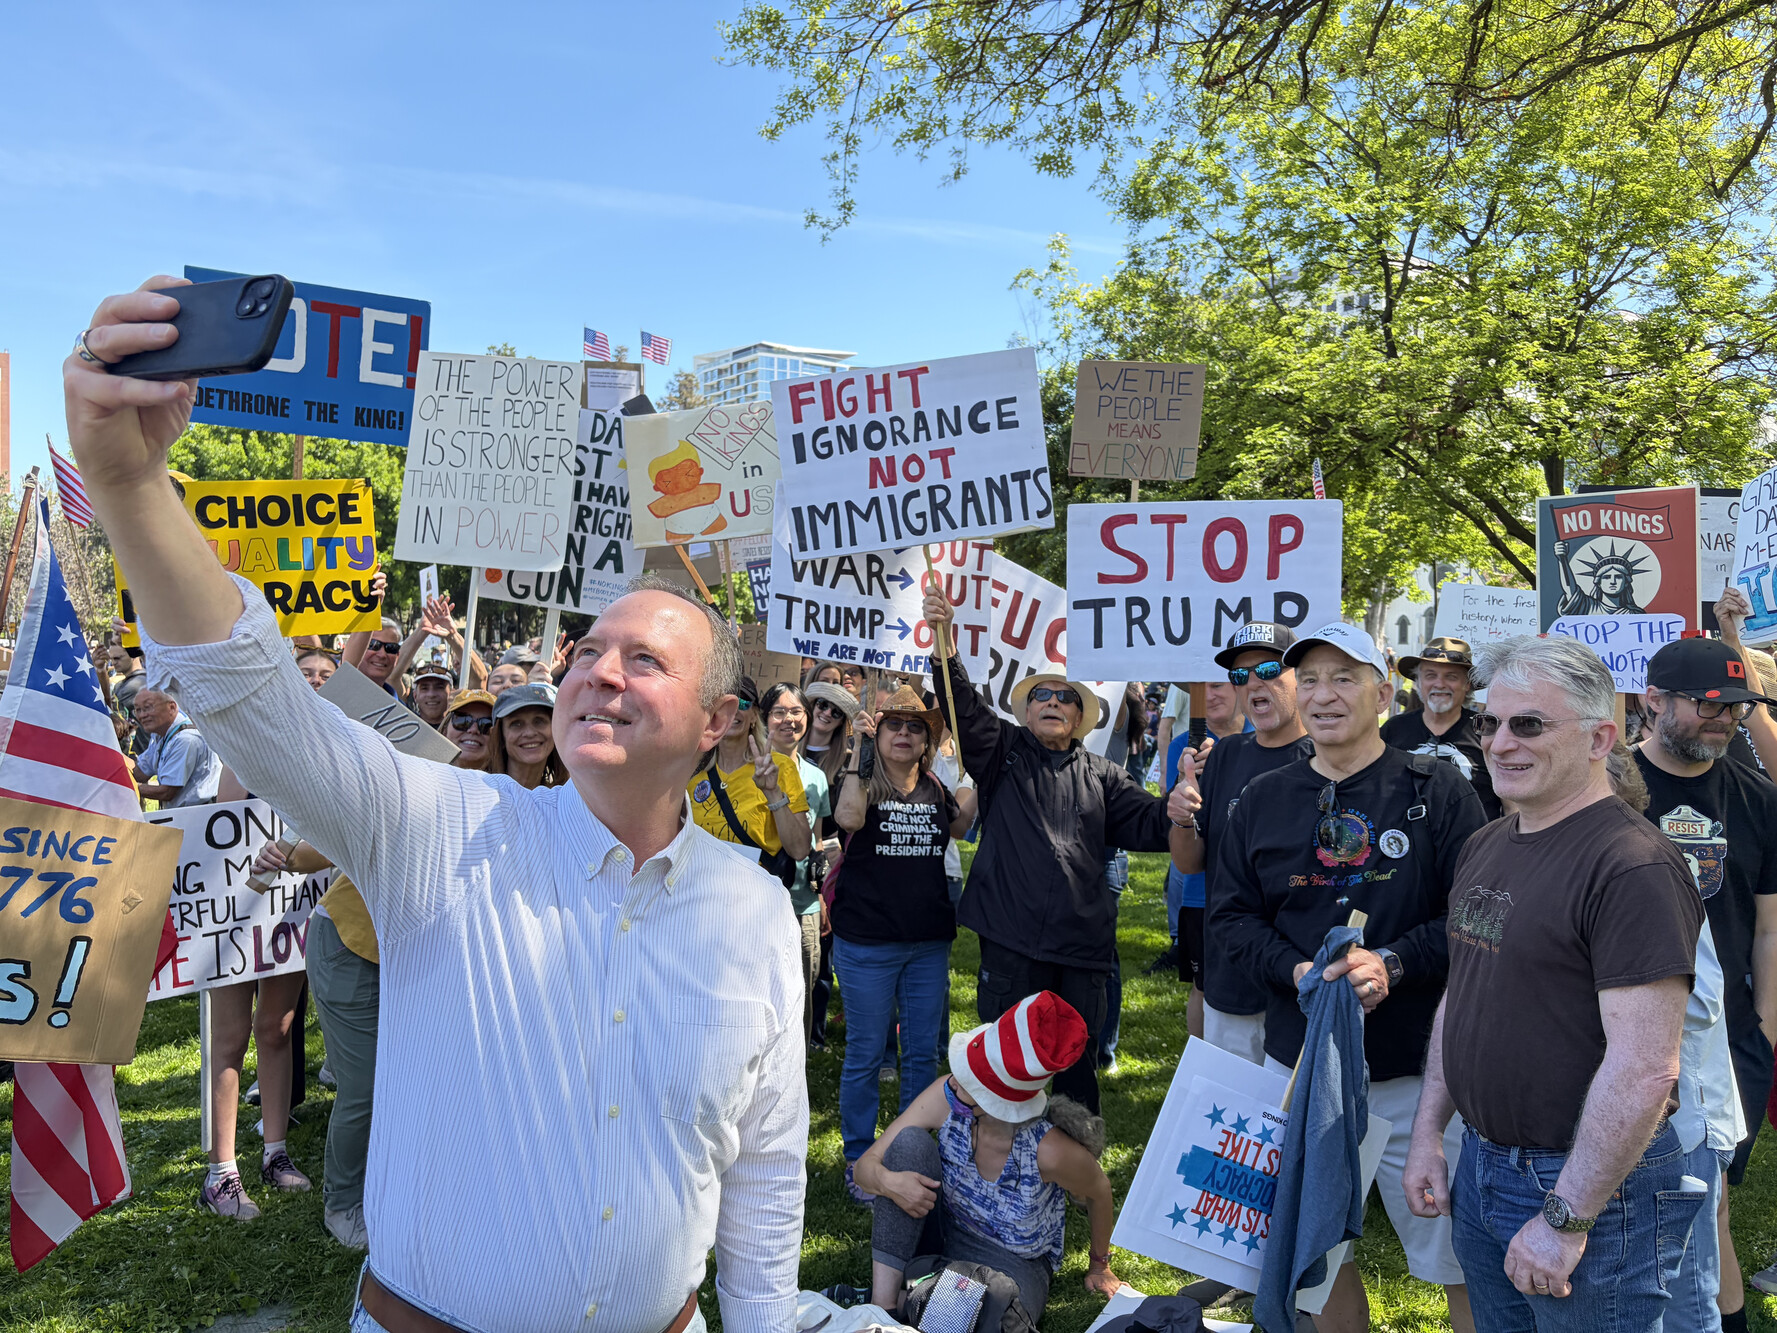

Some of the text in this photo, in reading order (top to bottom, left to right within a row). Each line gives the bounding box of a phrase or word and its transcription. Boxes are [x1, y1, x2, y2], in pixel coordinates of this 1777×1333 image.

[264, 297, 422, 389] OTE!
[432, 359, 476, 395] THE
[491, 360, 574, 400] POWER
[789, 366, 929, 424] FIGHT
[1094, 367, 1194, 395] WE THE
[194, 387, 404, 430] DETHRONE THE KING!
[419, 394, 566, 431] OF THE PEOPLE
[697, 409, 730, 444] NO
[1097, 395, 1182, 421] PEOPLE
[717, 402, 768, 459] KINGS
[792, 396, 1019, 464] IGNORANCE
[1107, 423, 1161, 440] MEANS
[422, 428, 573, 476] IS STRONGER
[742, 461, 763, 479] in
[869, 447, 955, 489] NOT
[1069, 442, 1196, 480] EVERYONE
[408, 470, 556, 507] THAN THE PEOPLE
[587, 482, 629, 508] HAV
[729, 484, 774, 518] US
[195, 493, 362, 529] CHOICE
[575, 504, 633, 541] RIGHT
[791, 466, 1052, 552] IMMIGRANTS
[1562, 509, 1664, 534] NO KINGS
[414, 505, 560, 556] IN POWER
[1097, 513, 1304, 584] STOP
[208, 536, 374, 572] UALITY
[564, 533, 624, 574] N A
[507, 565, 585, 608] GUN
[750, 566, 771, 583] HA
[789, 543, 989, 610] WAR OUT
[264, 580, 379, 616] RACY
[1463, 588, 1537, 608] For the first
[775, 592, 987, 657] TRUMP OT
[991, 579, 1067, 667] FUC
[1073, 591, 1309, 649] TRUMP
[1455, 624, 1478, 636] says
[1461, 609, 1498, 626] history,
[1501, 615, 1523, 625] when
[1555, 620, 1683, 644] STOP THE
[749, 662, 784, 678] ILT
[793, 638, 932, 674] WE ARE NOT AFR
[361, 703, 420, 742] NO
[205, 806, 284, 850] ON
[879, 821, 942, 835] CRIMINALS,
[889, 811, 931, 825] ARE NOT
[1667, 821, 1706, 835] RESIST
[0, 827, 117, 865] SINCE
[875, 844, 943, 856] PRESIDENT IS.
[891, 833, 932, 845] BUT THE
[267, 877, 329, 916] THAN
[1288, 874, 1308, 888] The
[1337, 878, 1348, 891] of
[1364, 868, 1397, 882] Dead
[202, 927, 247, 982] IS
[253, 917, 311, 974] LOV
[1261, 1111, 1284, 1125] KINGS
[1213, 1129, 1263, 1170] LIKE
[1202, 1160, 1278, 1211] OCRACY
[1191, 1189, 1243, 1229] WHAT
[1242, 1207, 1262, 1235] IS
